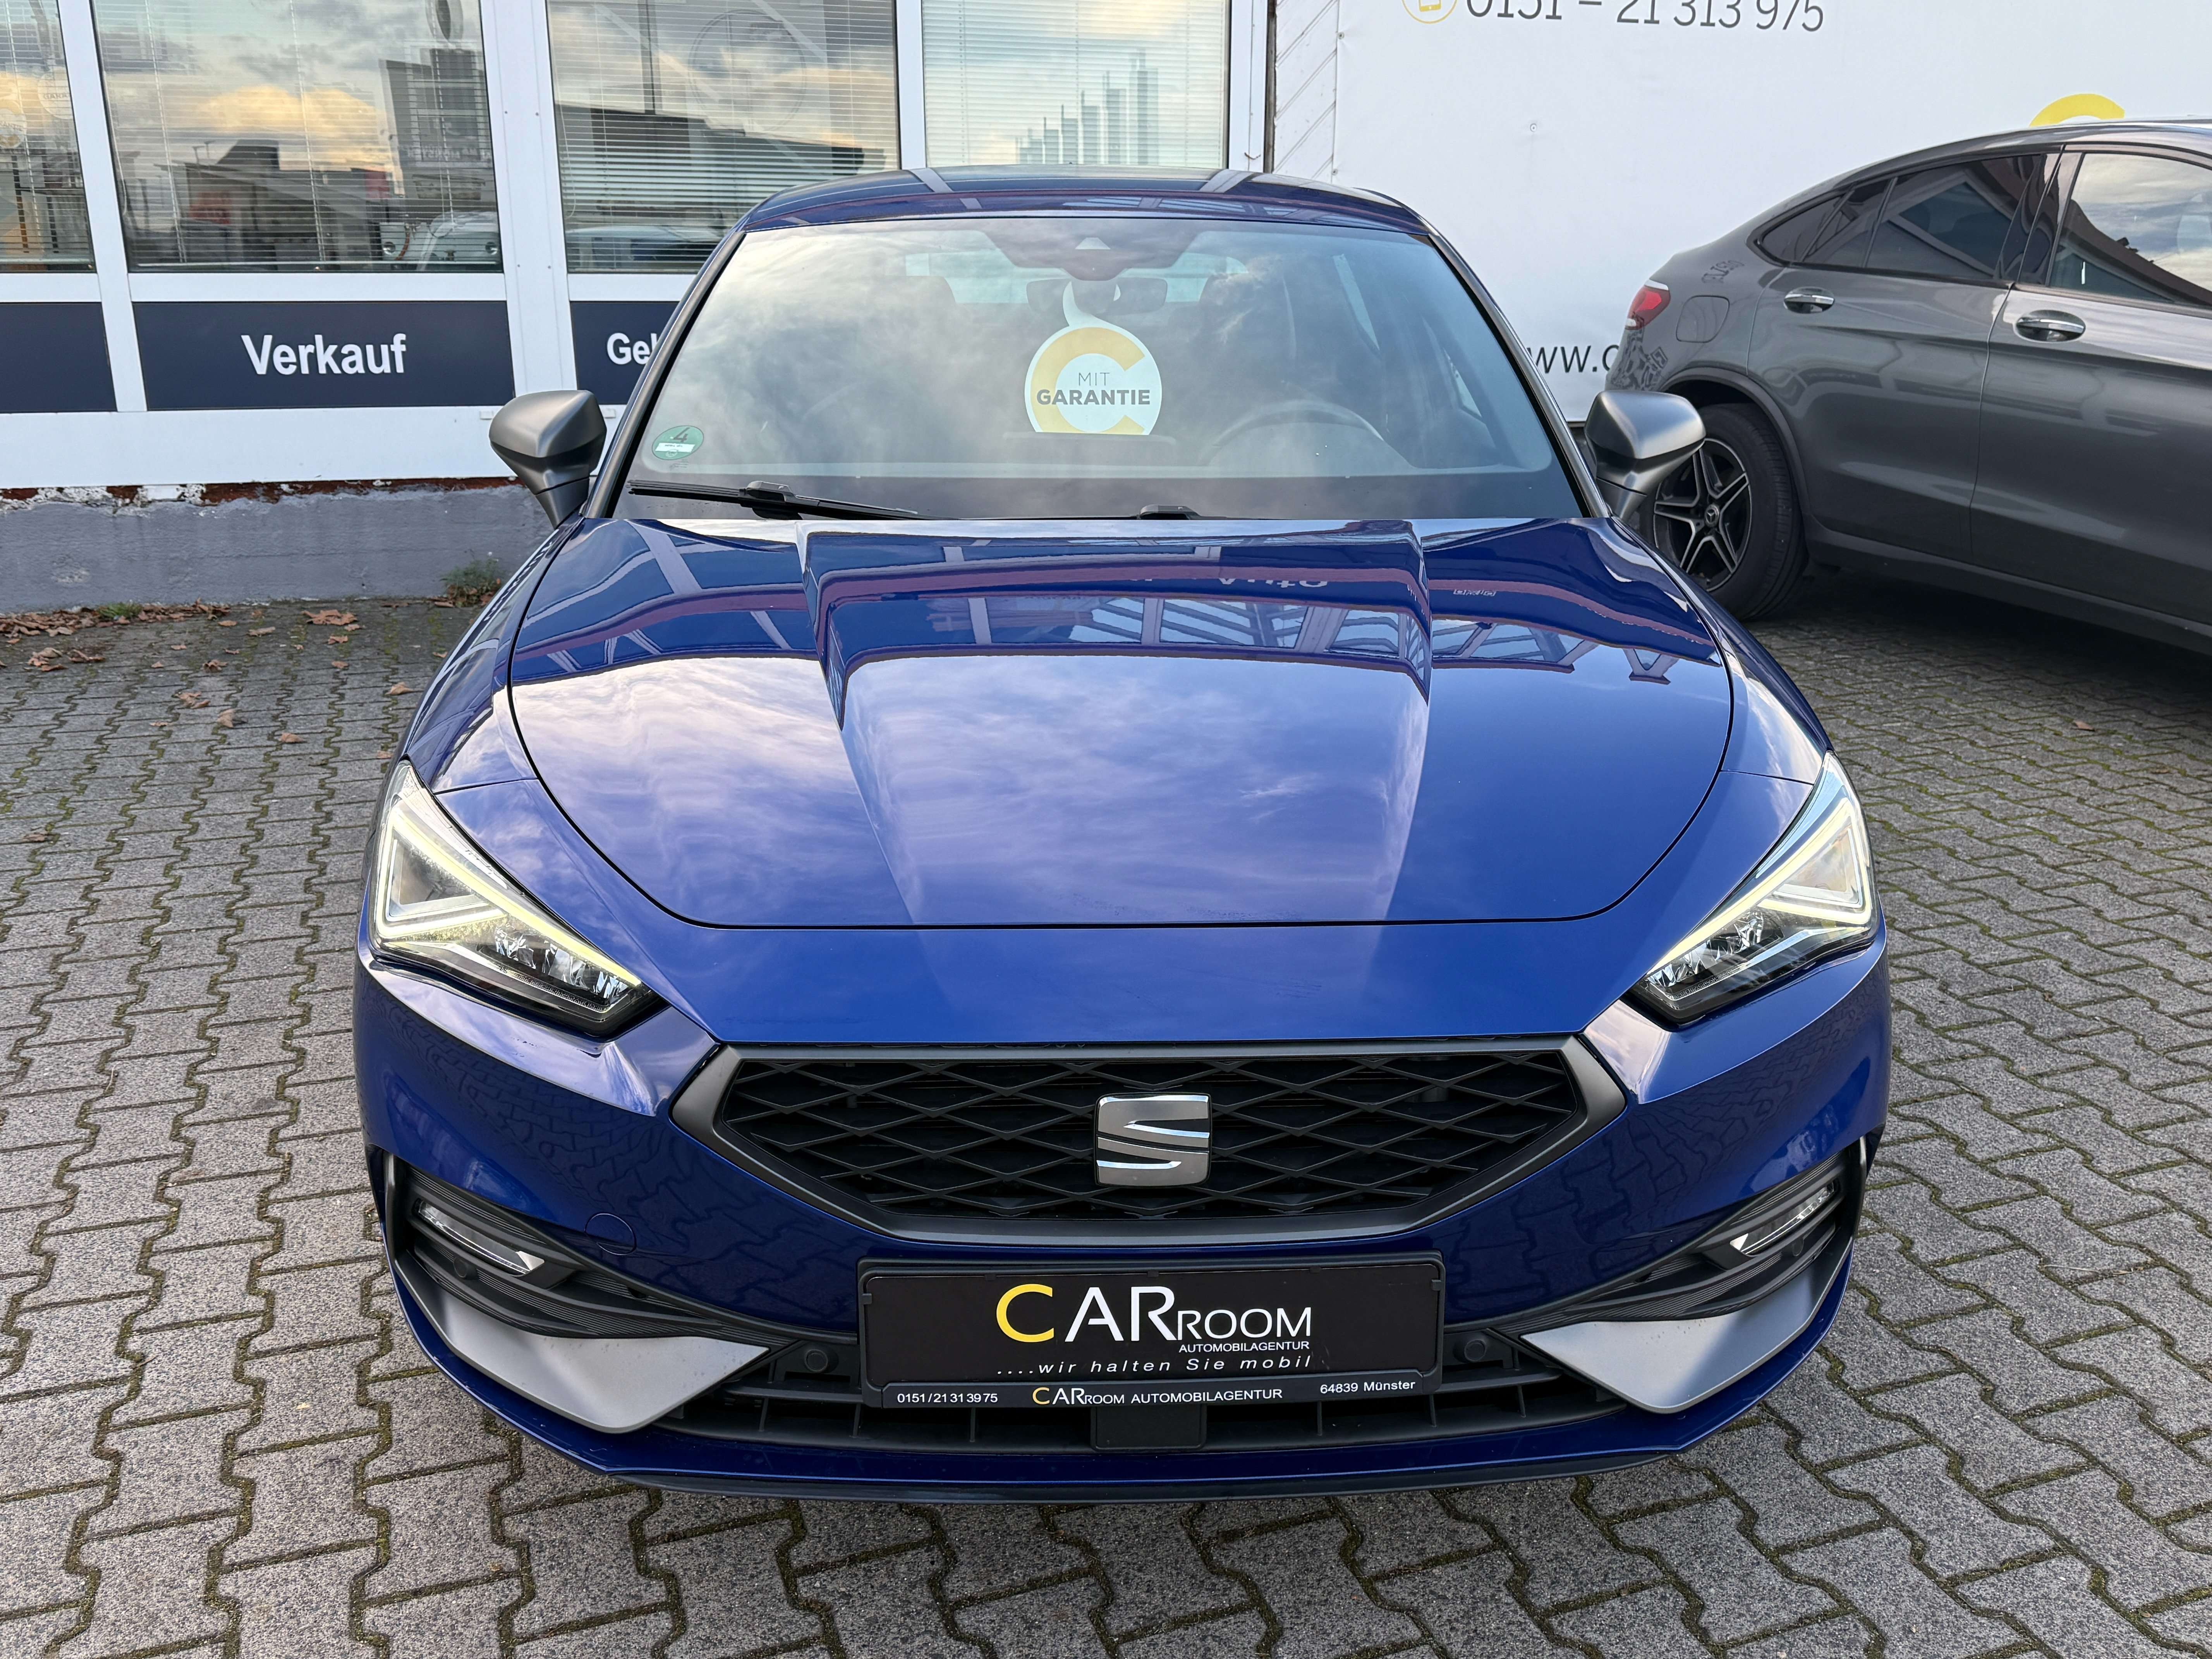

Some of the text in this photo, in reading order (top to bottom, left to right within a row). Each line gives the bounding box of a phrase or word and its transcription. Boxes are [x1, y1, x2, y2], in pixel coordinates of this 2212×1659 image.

[241, 333, 406, 375] Verkauf
[1079, 372, 1110, 386] MIT
[1037, 389, 1150, 405] GARANTIE
[673, 427, 690, 442] 4
[1179, 1341, 1310, 1353] AUTOMOBILAGENTUR
[1091, 1360, 1170, 1373] halten
[1187, 1358, 1225, 1371] Sie
[1240, 1355, 1311, 1369] mobil
[1320, 1381, 1415, 1394] 64839 Münster
[1131, 1388, 1283, 1404] AUTOMOBILAGENTUR
